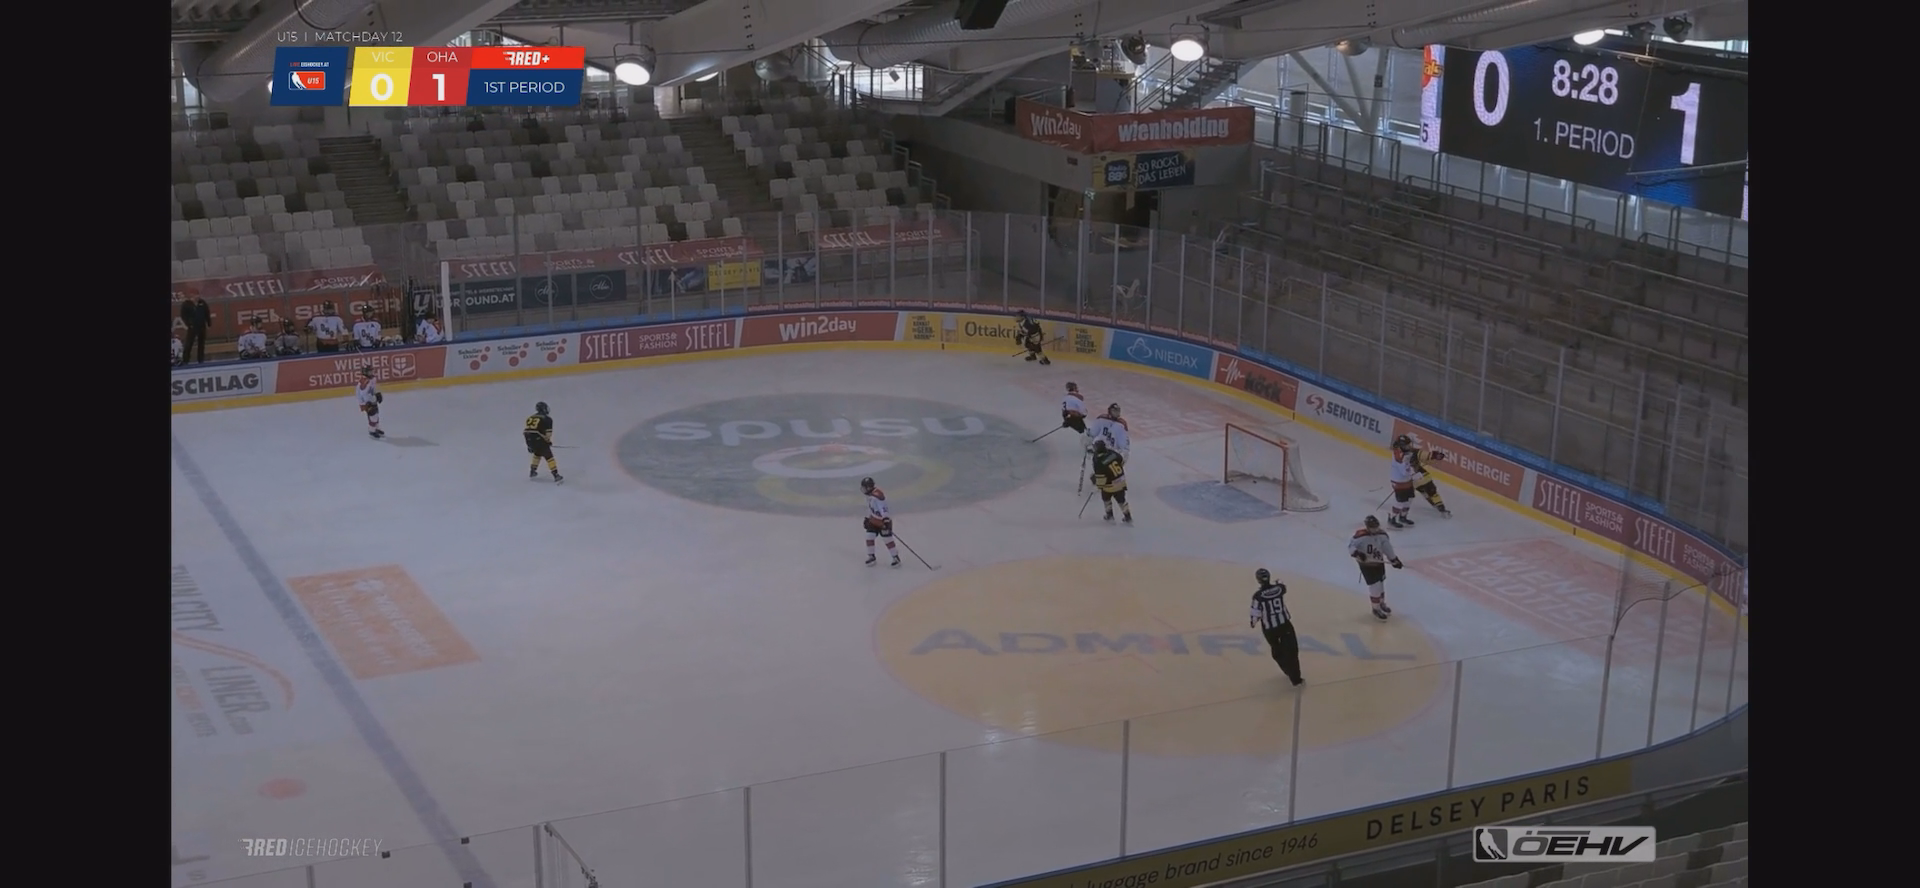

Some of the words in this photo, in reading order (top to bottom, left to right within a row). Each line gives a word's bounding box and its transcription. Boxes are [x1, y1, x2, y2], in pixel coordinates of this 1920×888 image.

[1473, 50, 1510, 127] 0
[1551, 59, 1619, 106] 8:28
[1031, 112, 1082, 139] win2day
[1118, 117, 1229, 143] wienholding
[1670, 82, 1701, 165] 1
[1533, 118, 1548, 142] 1.
[1555, 122, 1635, 159] PERIOD
[1138, 163, 1149, 173] SO
[1151, 155, 1179, 170] ROCKT
[1138, 172, 1156, 185] DAS
[1158, 165, 1186, 181] LEBEN
[585, 332, 632, 359] STEFFL
[685, 322, 730, 350] STEFFL
[779, 315, 857, 342] win2day
[639, 340, 678, 350] FASHION
[1155, 347, 1198, 369] NIEDAX
[334, 353, 390, 370] WIENER
[525, 417, 541, 430] 23
[654, 416, 985, 446] spusu
[1326, 402, 1381, 434] SERVOTEL
[1108, 461, 1123, 478] 16
[1460, 450, 1511, 486] ENERGIE
[1539, 479, 1581, 523] STEFFL
[1635, 516, 1676, 564] STEFFL
[1584, 511, 1623, 534] FASHION
[1269, 599, 1283, 615] 19
[909, 628, 1417, 661] ADMIRAL
[1366, 796, 1486, 840] DELSEY
[1501, 775, 1590, 812] PARIS
[1165, 853, 1221, 881] brand
[1225, 843, 1273, 867] since
[1281, 832, 1319, 855] 1946
